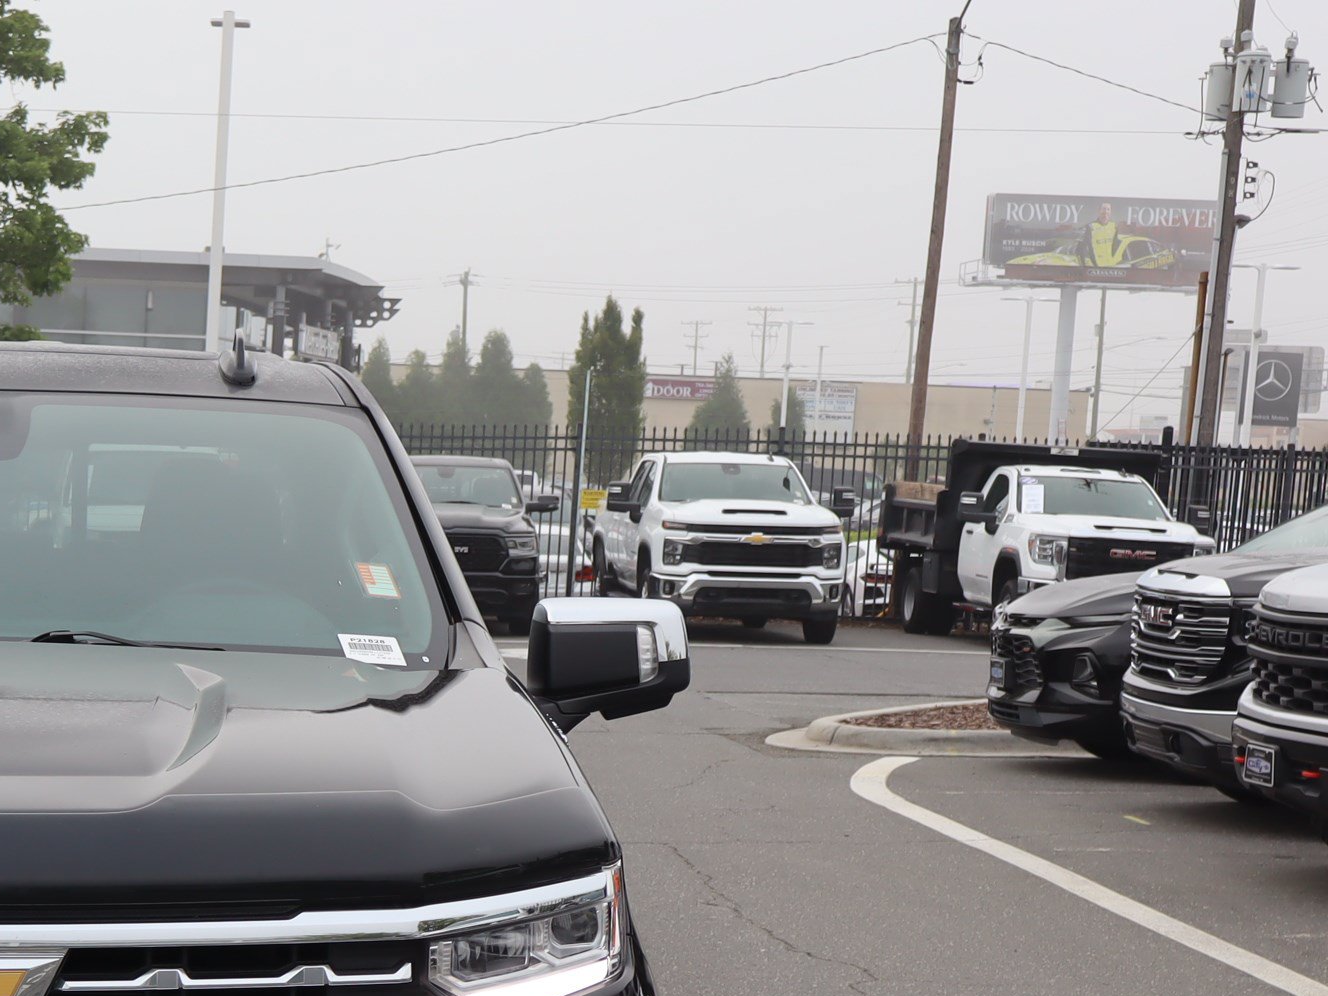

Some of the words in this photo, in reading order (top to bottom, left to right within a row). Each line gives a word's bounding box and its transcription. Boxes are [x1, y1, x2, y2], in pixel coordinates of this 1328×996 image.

[1006, 202, 1084, 224] ROWDY
[653, 384, 692, 398] DOOR
[1109, 548, 1157, 560] GMC
